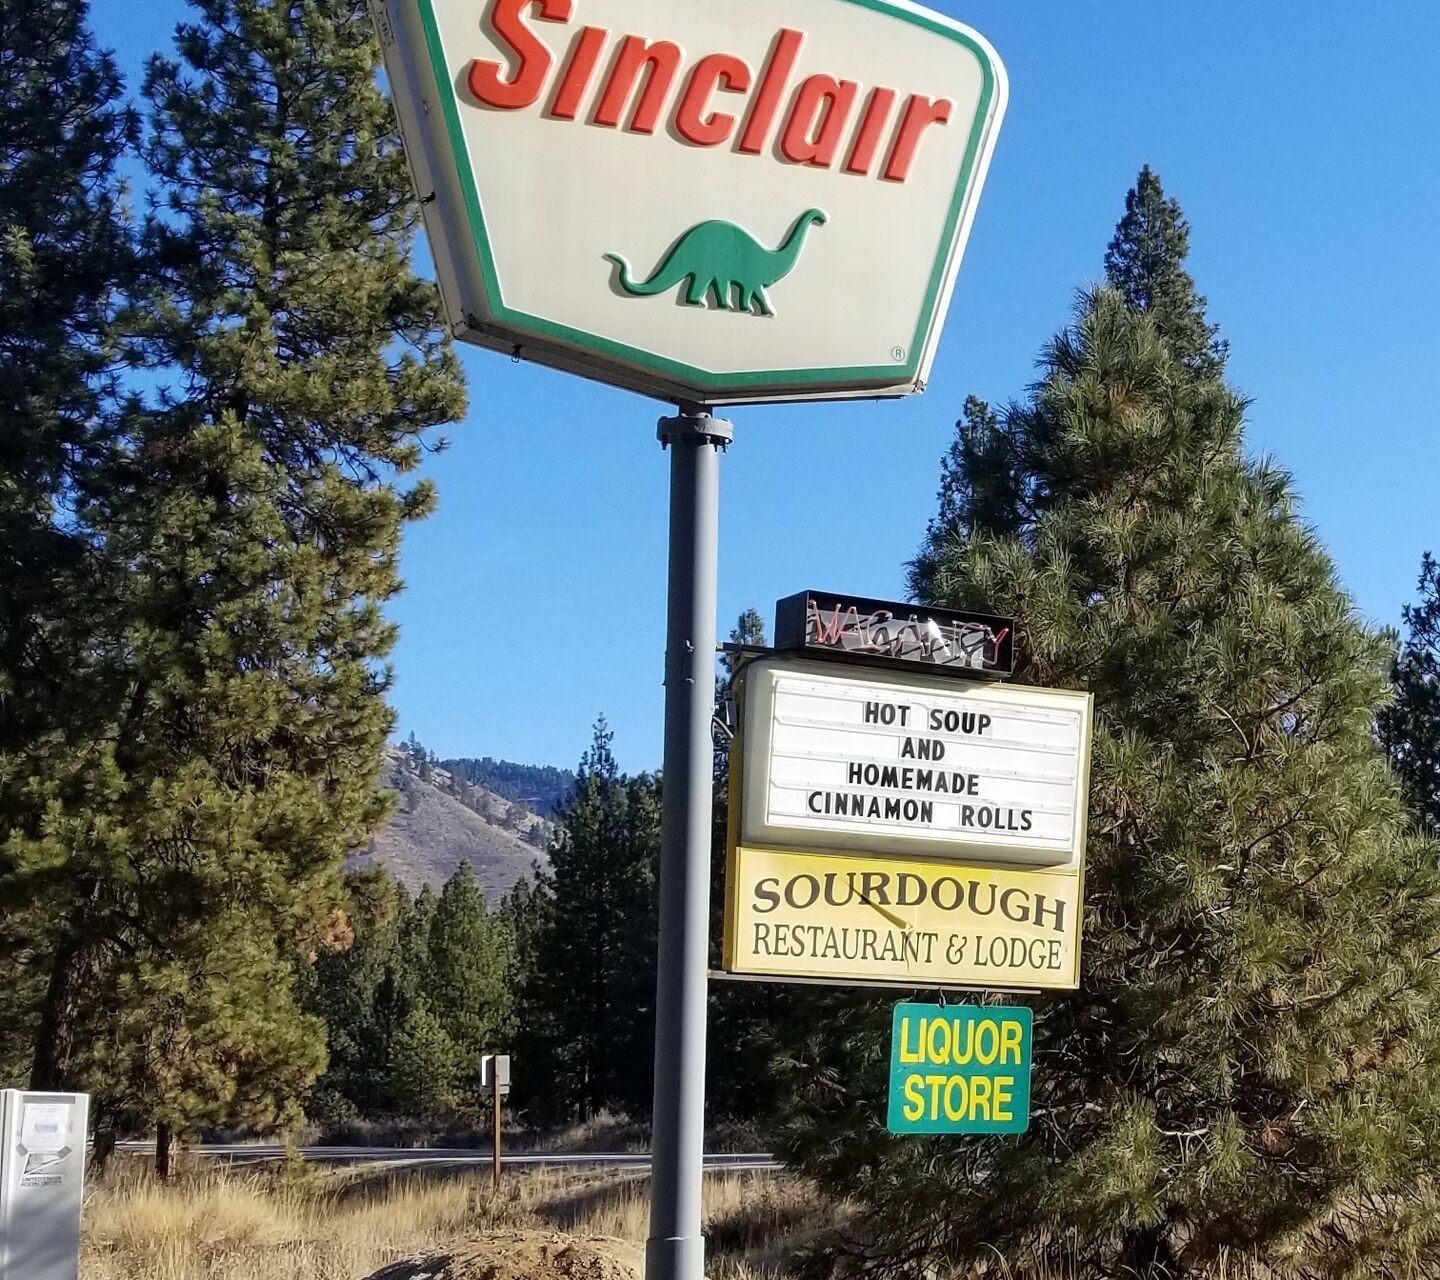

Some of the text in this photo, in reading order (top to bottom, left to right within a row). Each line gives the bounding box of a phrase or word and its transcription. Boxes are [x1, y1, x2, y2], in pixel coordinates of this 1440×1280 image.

[808, 599, 1009, 666] VACANCY
[864, 701, 992, 735] HOT SOUP
[901, 736, 946, 762] AND
[848, 762, 980, 796] HOMEMADE
[808, 790, 1033, 832] CINNAMON ROLLS
[752, 871, 1067, 933] SOURDOUGH
[752, 922, 1062, 970] RESTAURANT & LODGE
[899, 1017, 1022, 1066] LIQUOR
[903, 1074, 1015, 1122] STORE
